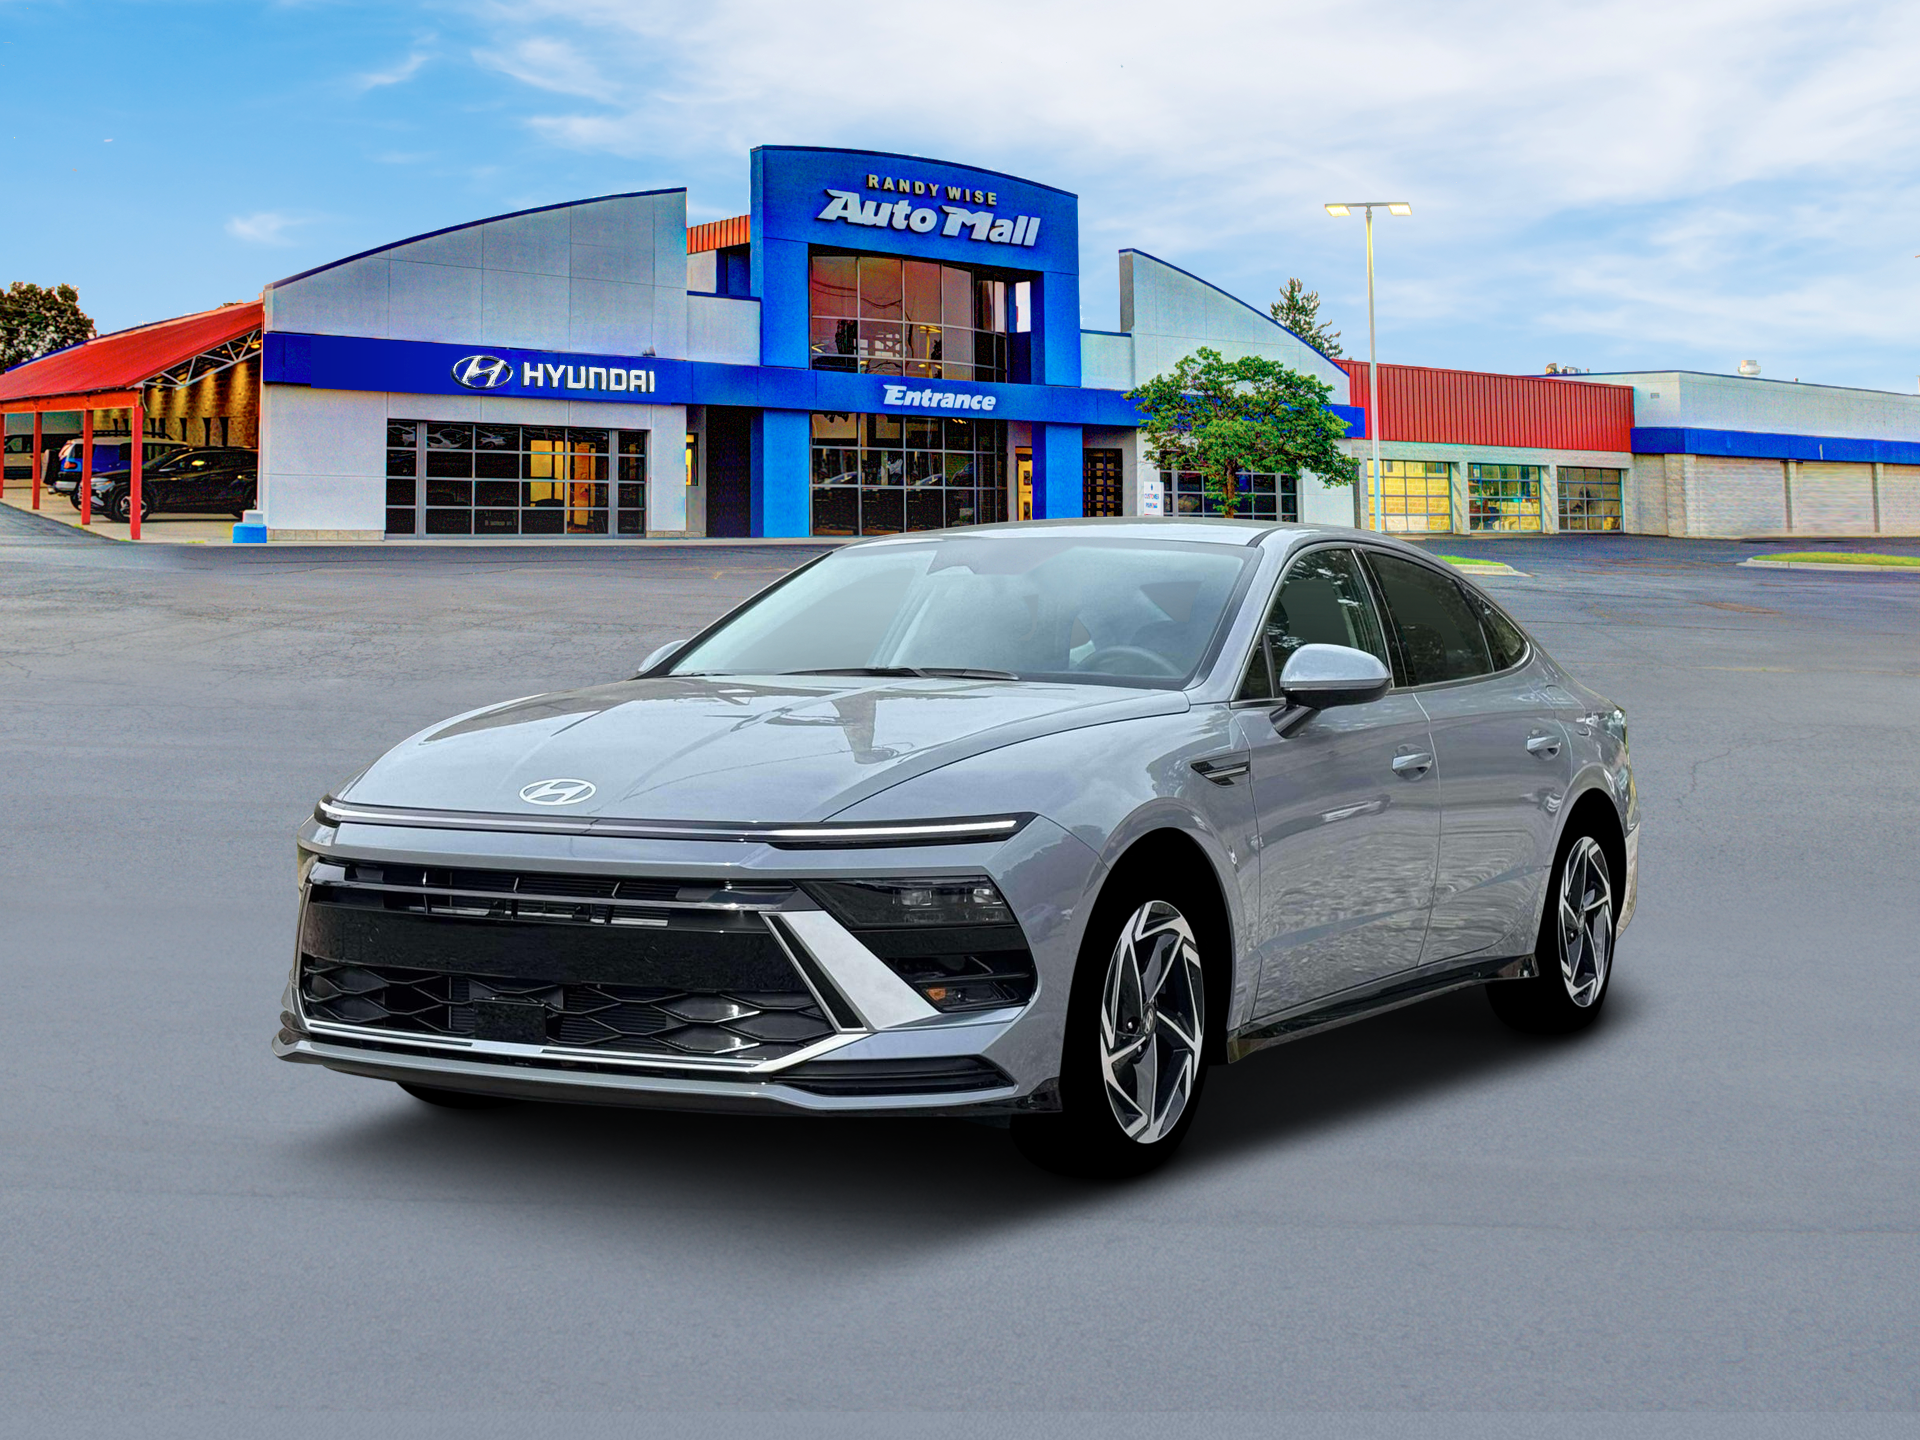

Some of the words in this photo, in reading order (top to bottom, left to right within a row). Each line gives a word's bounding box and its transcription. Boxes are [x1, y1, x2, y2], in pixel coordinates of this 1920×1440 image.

[867, 174, 939, 197] RANDY
[946, 186, 997, 206] WISE
[816, 188, 938, 233] Auto
[941, 205, 1041, 247] Mall
[522, 362, 655, 393] HYUNDAI
[883, 384, 997, 411] Entrance
